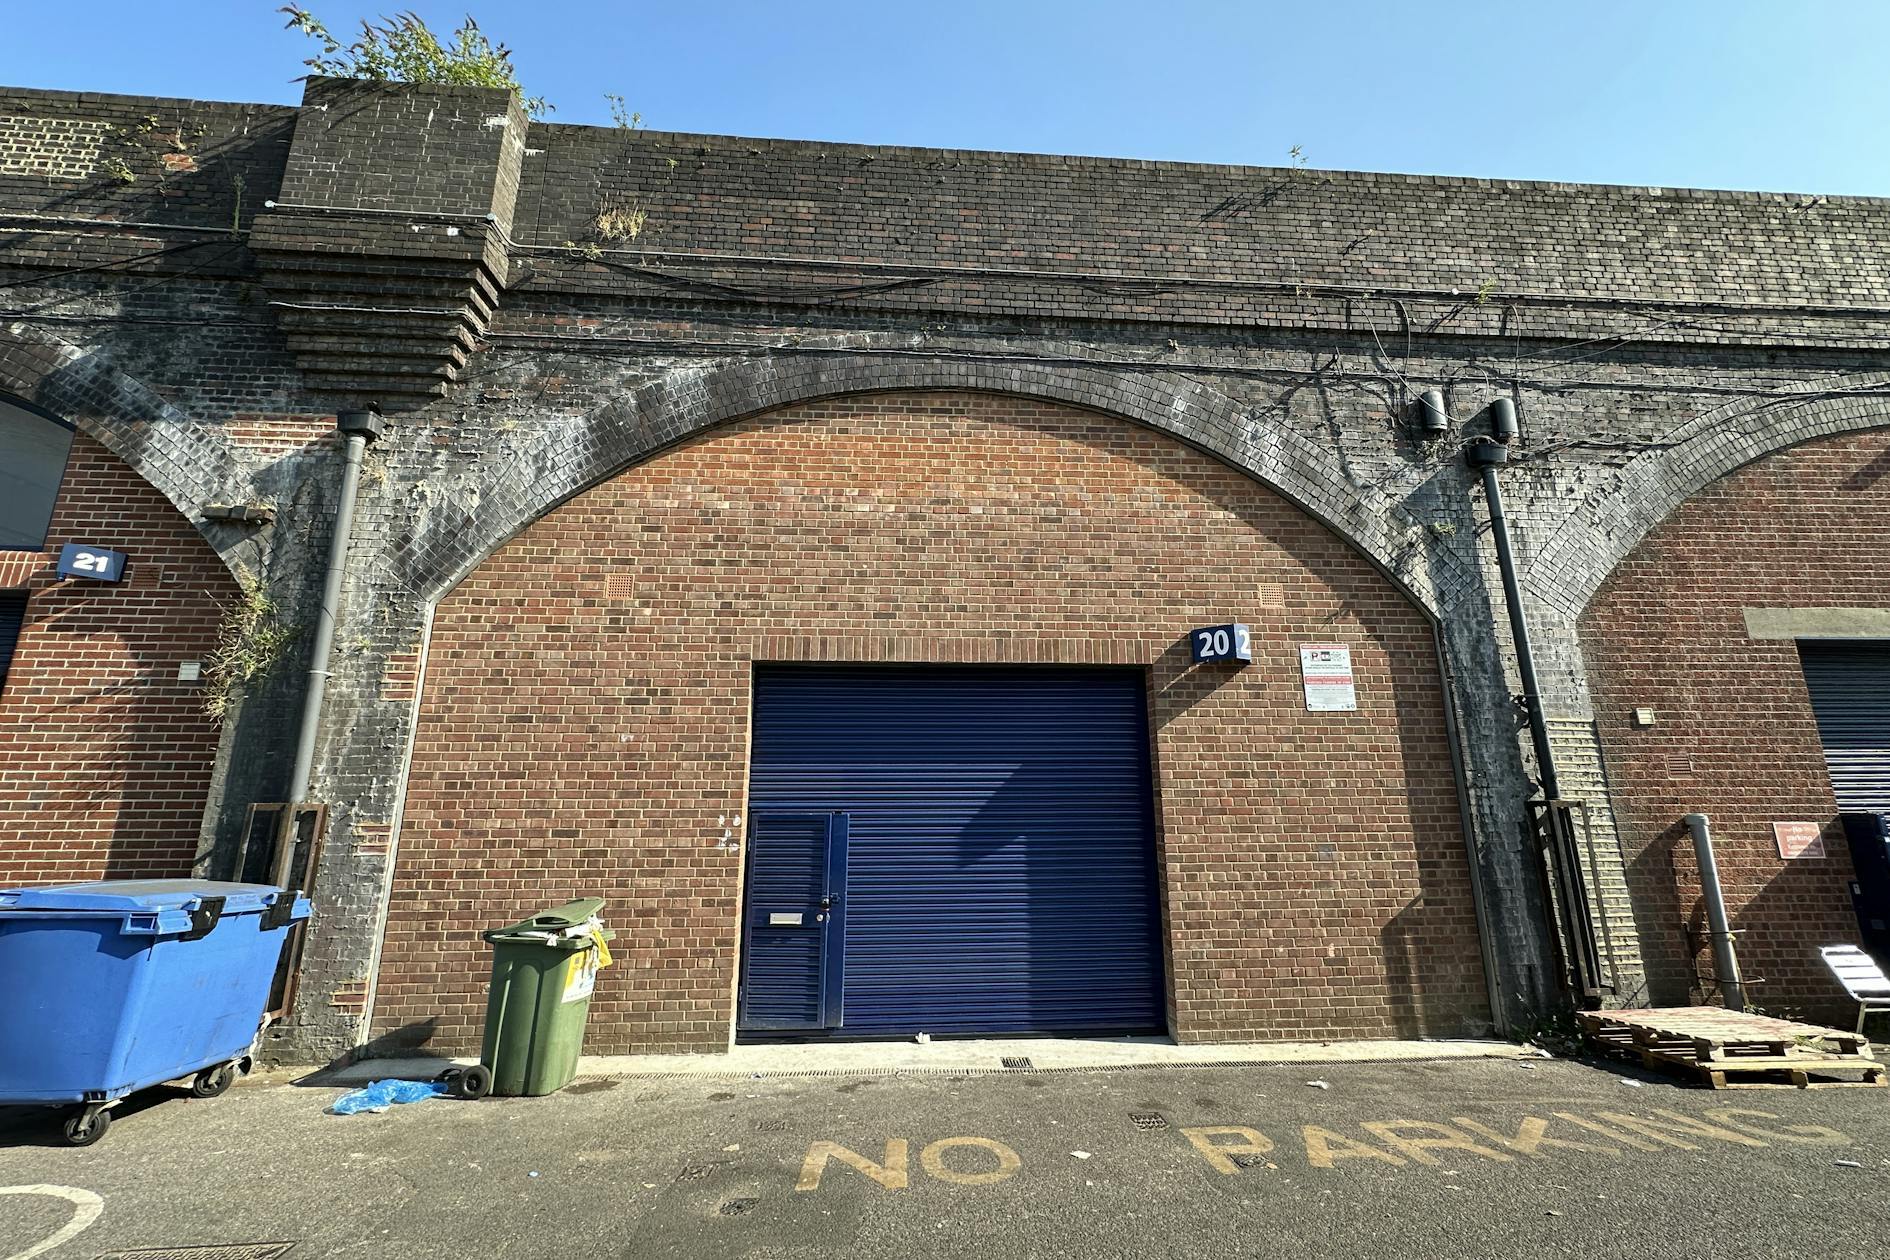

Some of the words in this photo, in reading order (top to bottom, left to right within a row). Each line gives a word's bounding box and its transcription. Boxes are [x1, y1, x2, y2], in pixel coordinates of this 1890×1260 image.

[73, 552, 109, 573] 21
[1198, 629, 1230, 658] 20
[795, 1136, 1022, 1191] NO
